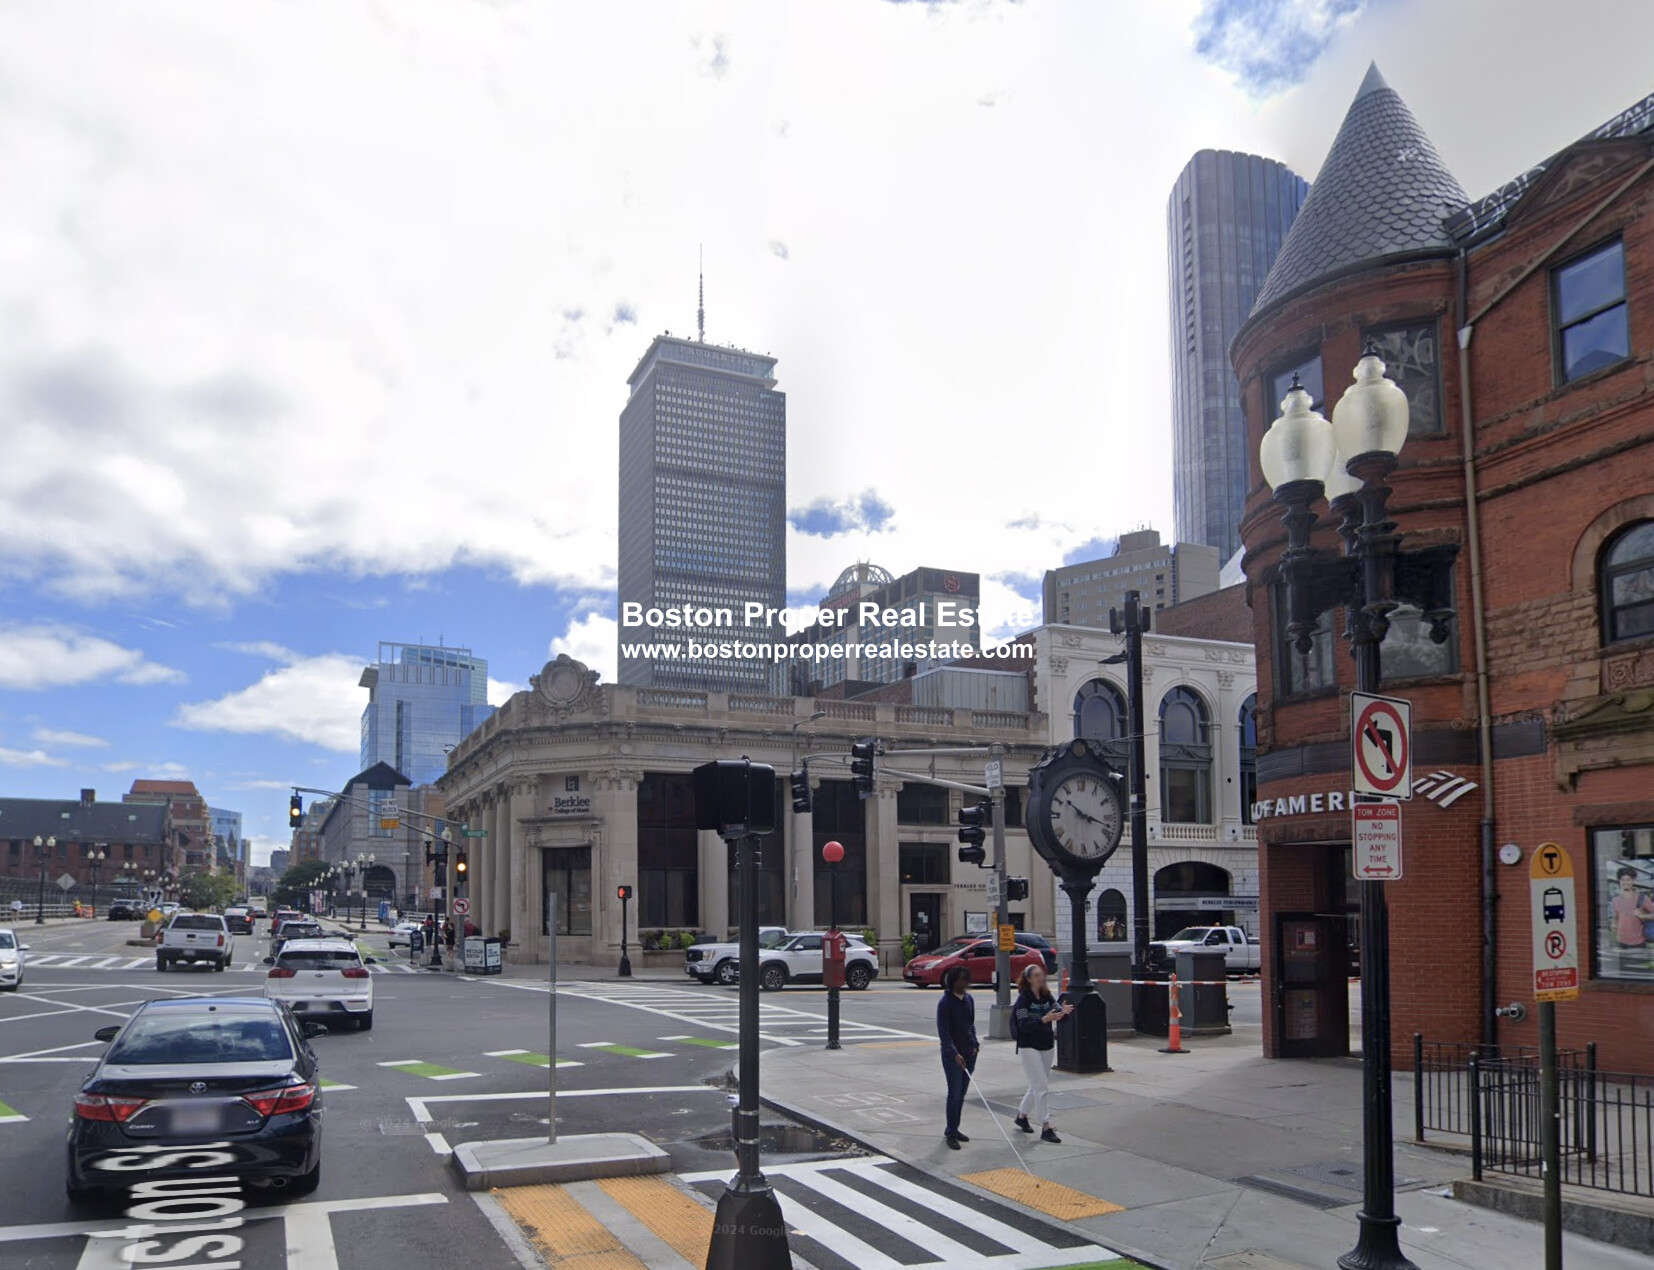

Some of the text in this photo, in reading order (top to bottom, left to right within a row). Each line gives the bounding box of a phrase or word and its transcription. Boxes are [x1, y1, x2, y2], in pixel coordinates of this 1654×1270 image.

[680, 345, 758, 367] PRUDENTIAL
[554, 796, 590, 807] Berklee
[1357, 808, 1397, 816] TOW ZONE
[1371, 822, 1383, 830] NO
[1358, 833, 1397, 841] STOPPING
[1369, 844, 1387, 852] ANY
[1369, 855, 1387, 863] TIME
